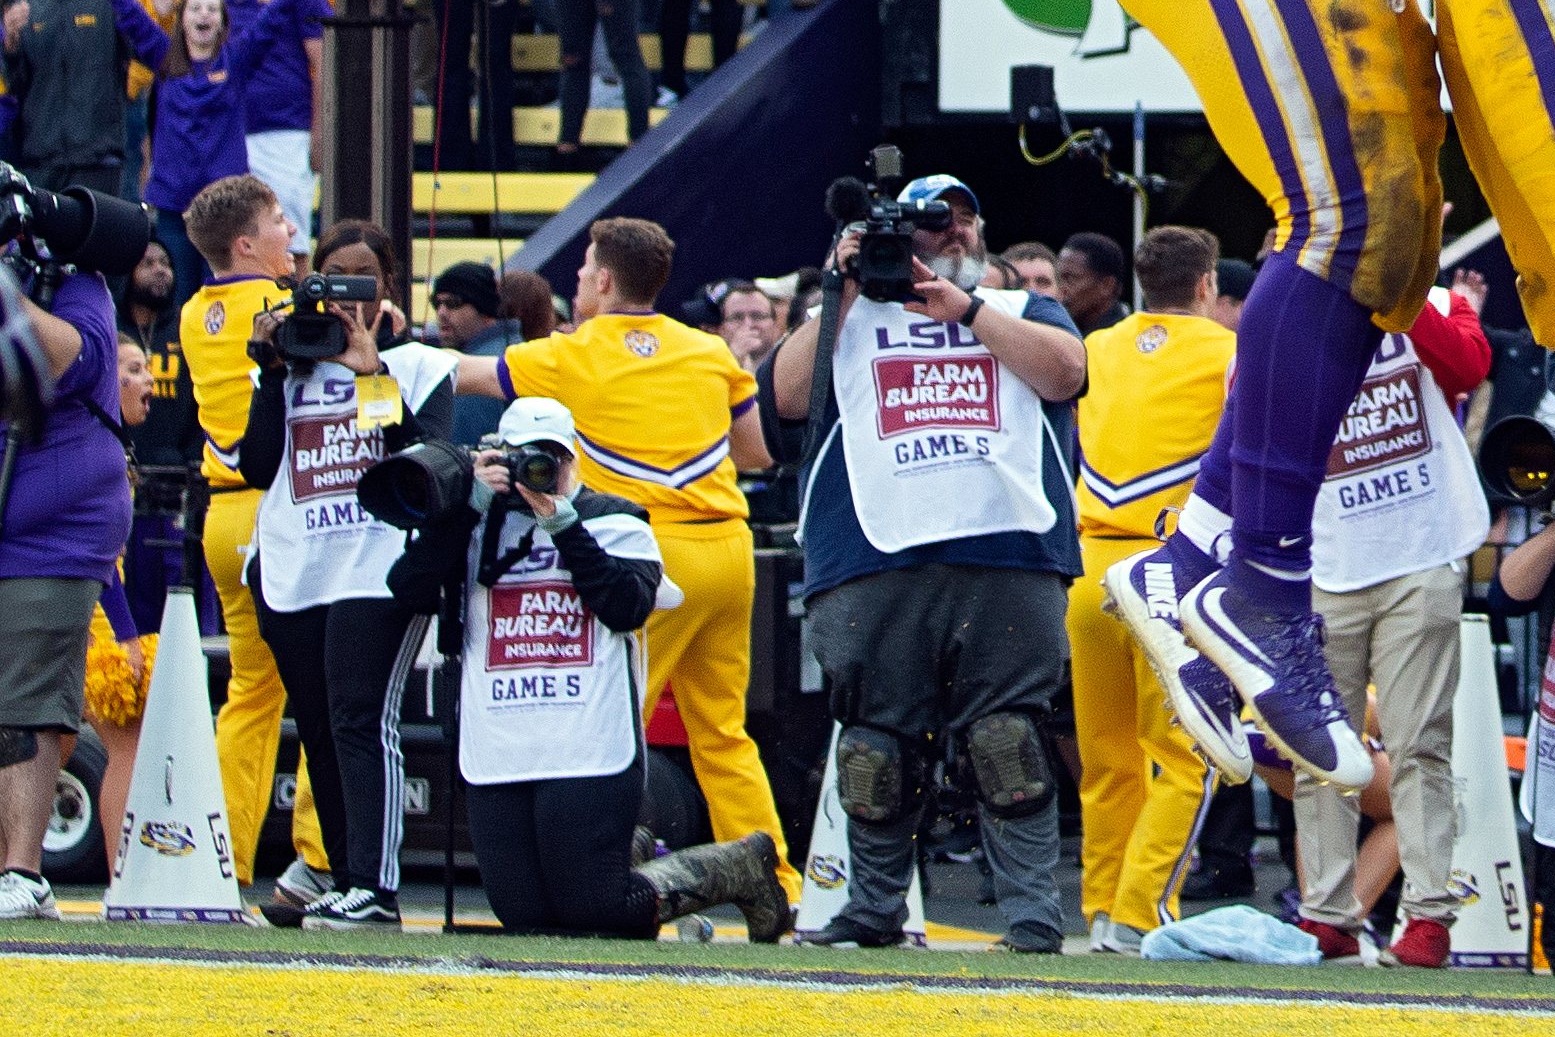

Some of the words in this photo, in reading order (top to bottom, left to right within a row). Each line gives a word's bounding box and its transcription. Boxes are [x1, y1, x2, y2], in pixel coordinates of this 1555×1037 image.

[913, 364, 986, 385] FARM
[292, 378, 356, 407] LS
[885, 383, 989, 408] BUREAU
[905, 407, 989, 423] INSURANCE
[1333, 399, 1420, 446] UREAU
[296, 439, 385, 473] BUREAU
[894, 435, 968, 465] GAME
[1344, 430, 1424, 464] INSURANCE
[1338, 469, 1412, 509] GAME
[1418, 463, 1431, 487] 5
[520, 591, 584, 615] FARM
[1144, 562, 1179, 619] NIKE
[494, 613, 583, 639] BUREAU
[505, 643, 582, 658] INSURANCE
[491, 675, 556, 700] GAME
[566, 674, 580, 697] 5
[207, 812, 233, 880] LSU
[1495, 862, 1522, 931] LSU
